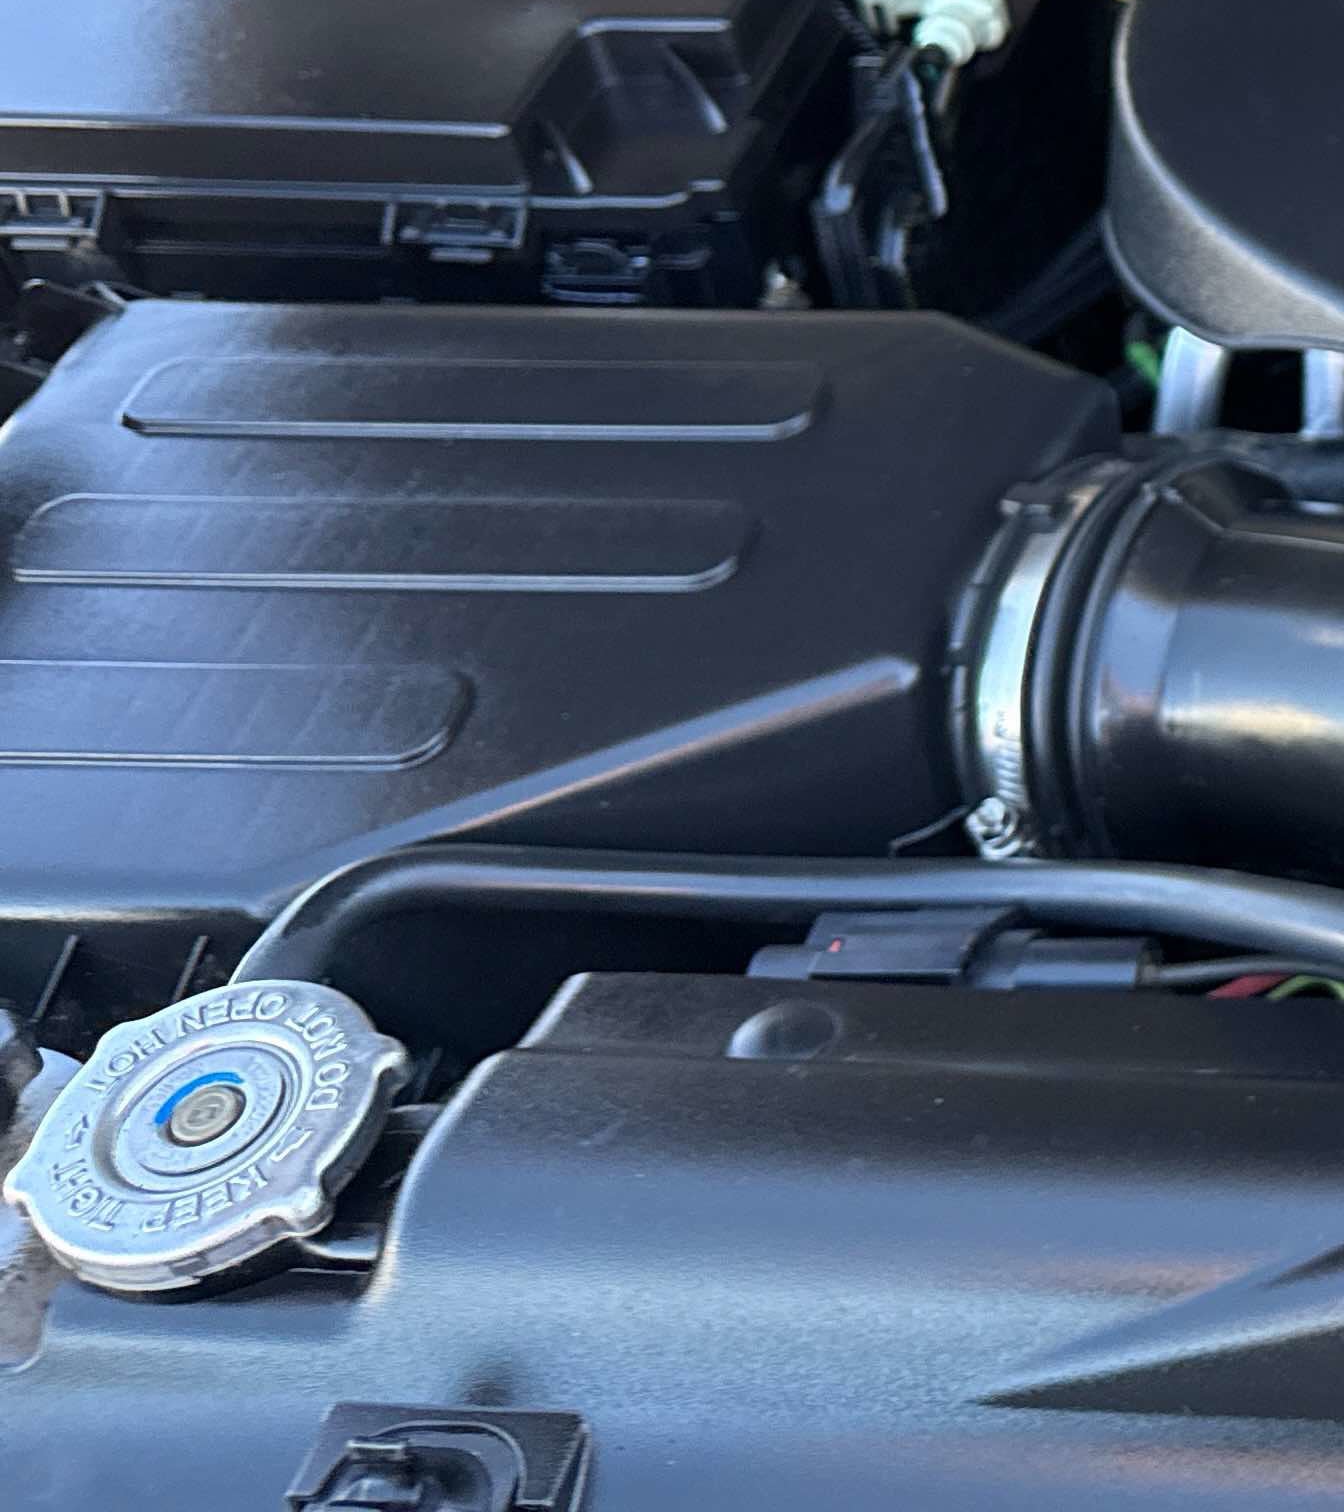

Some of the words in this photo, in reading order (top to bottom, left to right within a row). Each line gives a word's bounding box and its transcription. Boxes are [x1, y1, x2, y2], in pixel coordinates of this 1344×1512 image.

[173, 991, 290, 1038] OPEN
[284, 1004, 349, 1062] NOT
[86, 1029, 167, 1093] HOT
[305, 1061, 348, 1111] DO
[52, 1158, 125, 1233] TIGHT
[141, 1164, 269, 1234] KEEP
